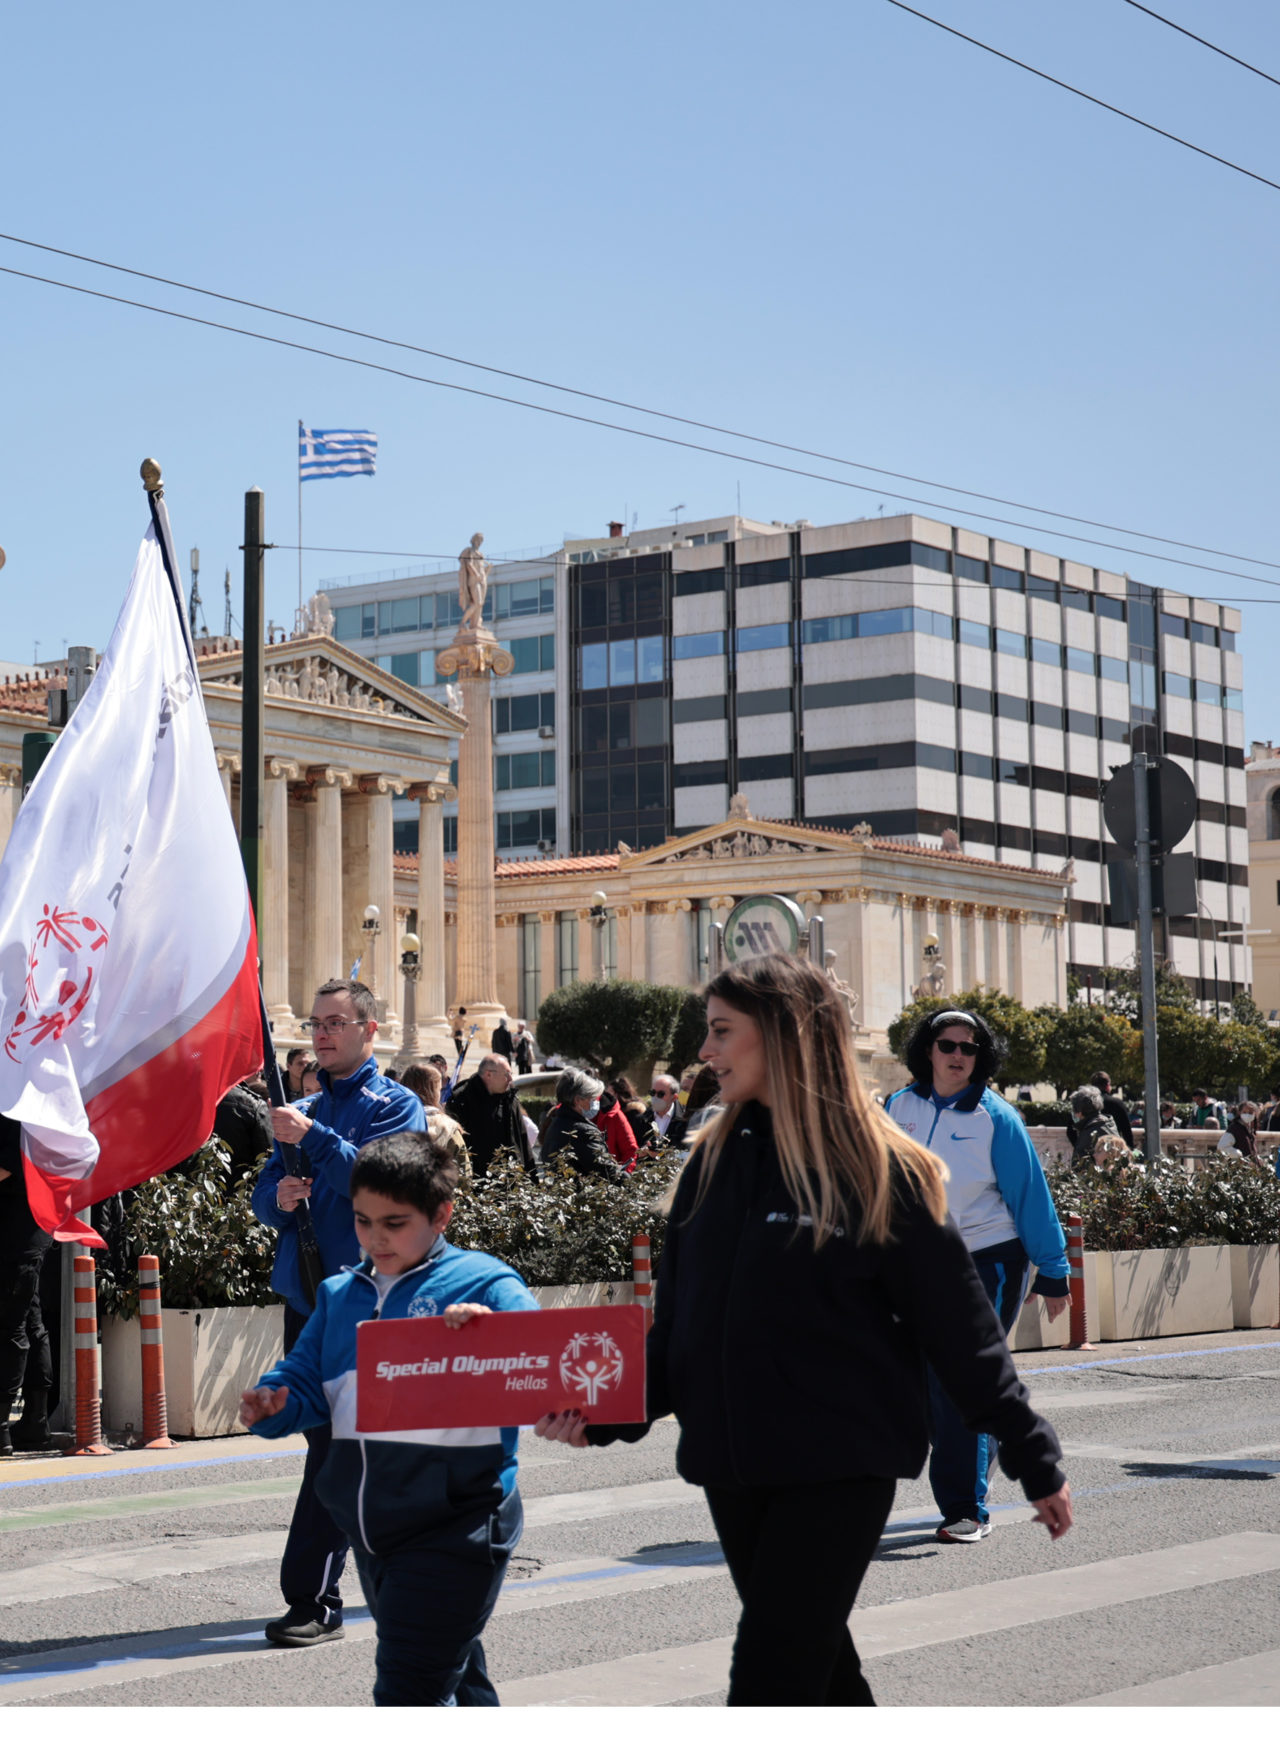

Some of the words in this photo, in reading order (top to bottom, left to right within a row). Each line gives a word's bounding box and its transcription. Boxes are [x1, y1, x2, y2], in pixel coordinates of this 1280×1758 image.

[375, 1357, 448, 1381] Special
[451, 1352, 550, 1376] Olympics
[505, 1375, 548, 1391] Hellas
